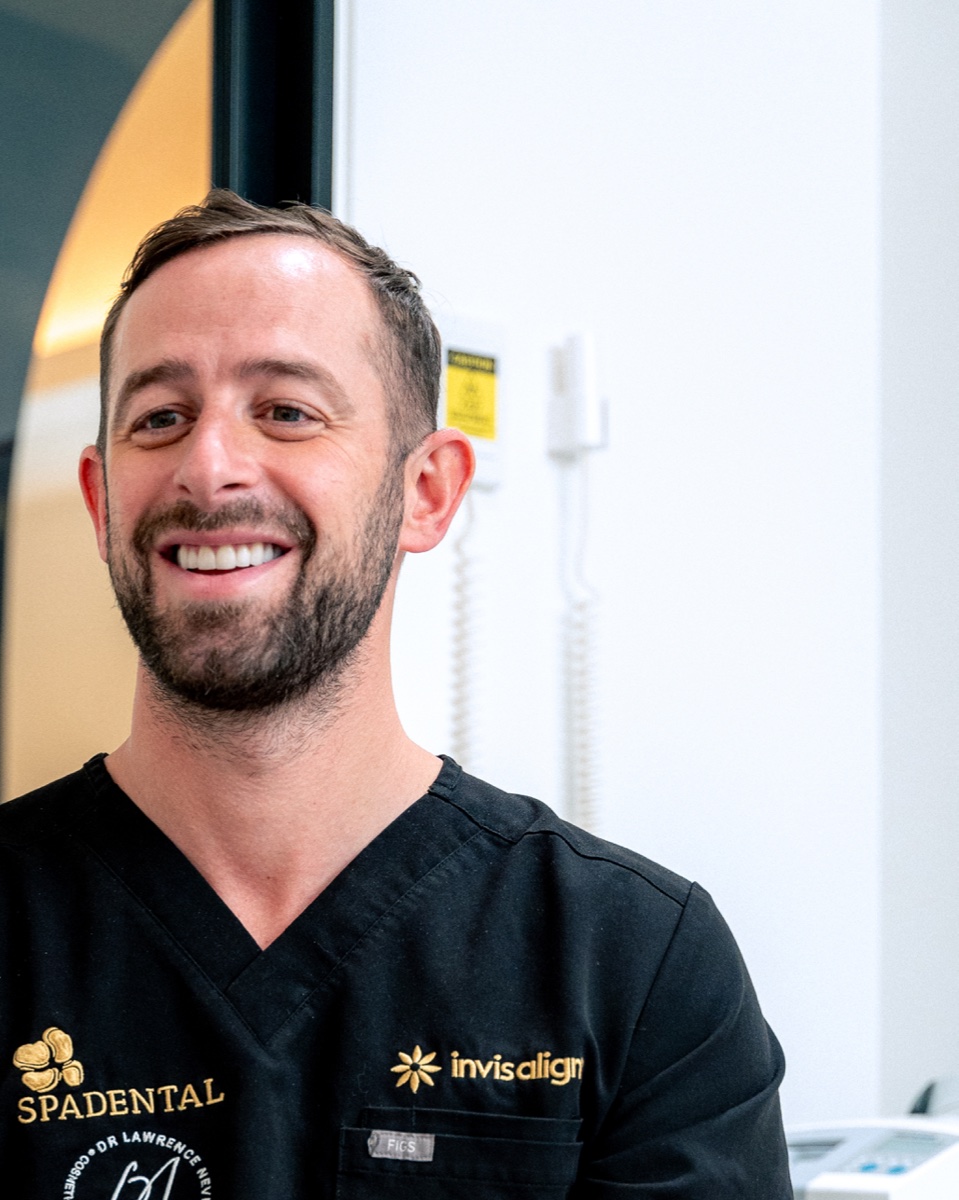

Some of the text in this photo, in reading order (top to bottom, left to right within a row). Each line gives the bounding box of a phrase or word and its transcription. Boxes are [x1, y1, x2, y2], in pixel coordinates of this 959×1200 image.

[450, 1050, 585, 1087] invisalign
[17, 1078, 226, 1124] SPADENTAL
[95, 1135, 119, 1154] DR
[122, 1131, 202, 1167] LAWRENCE
[386, 1138, 417, 1154] FIGS
